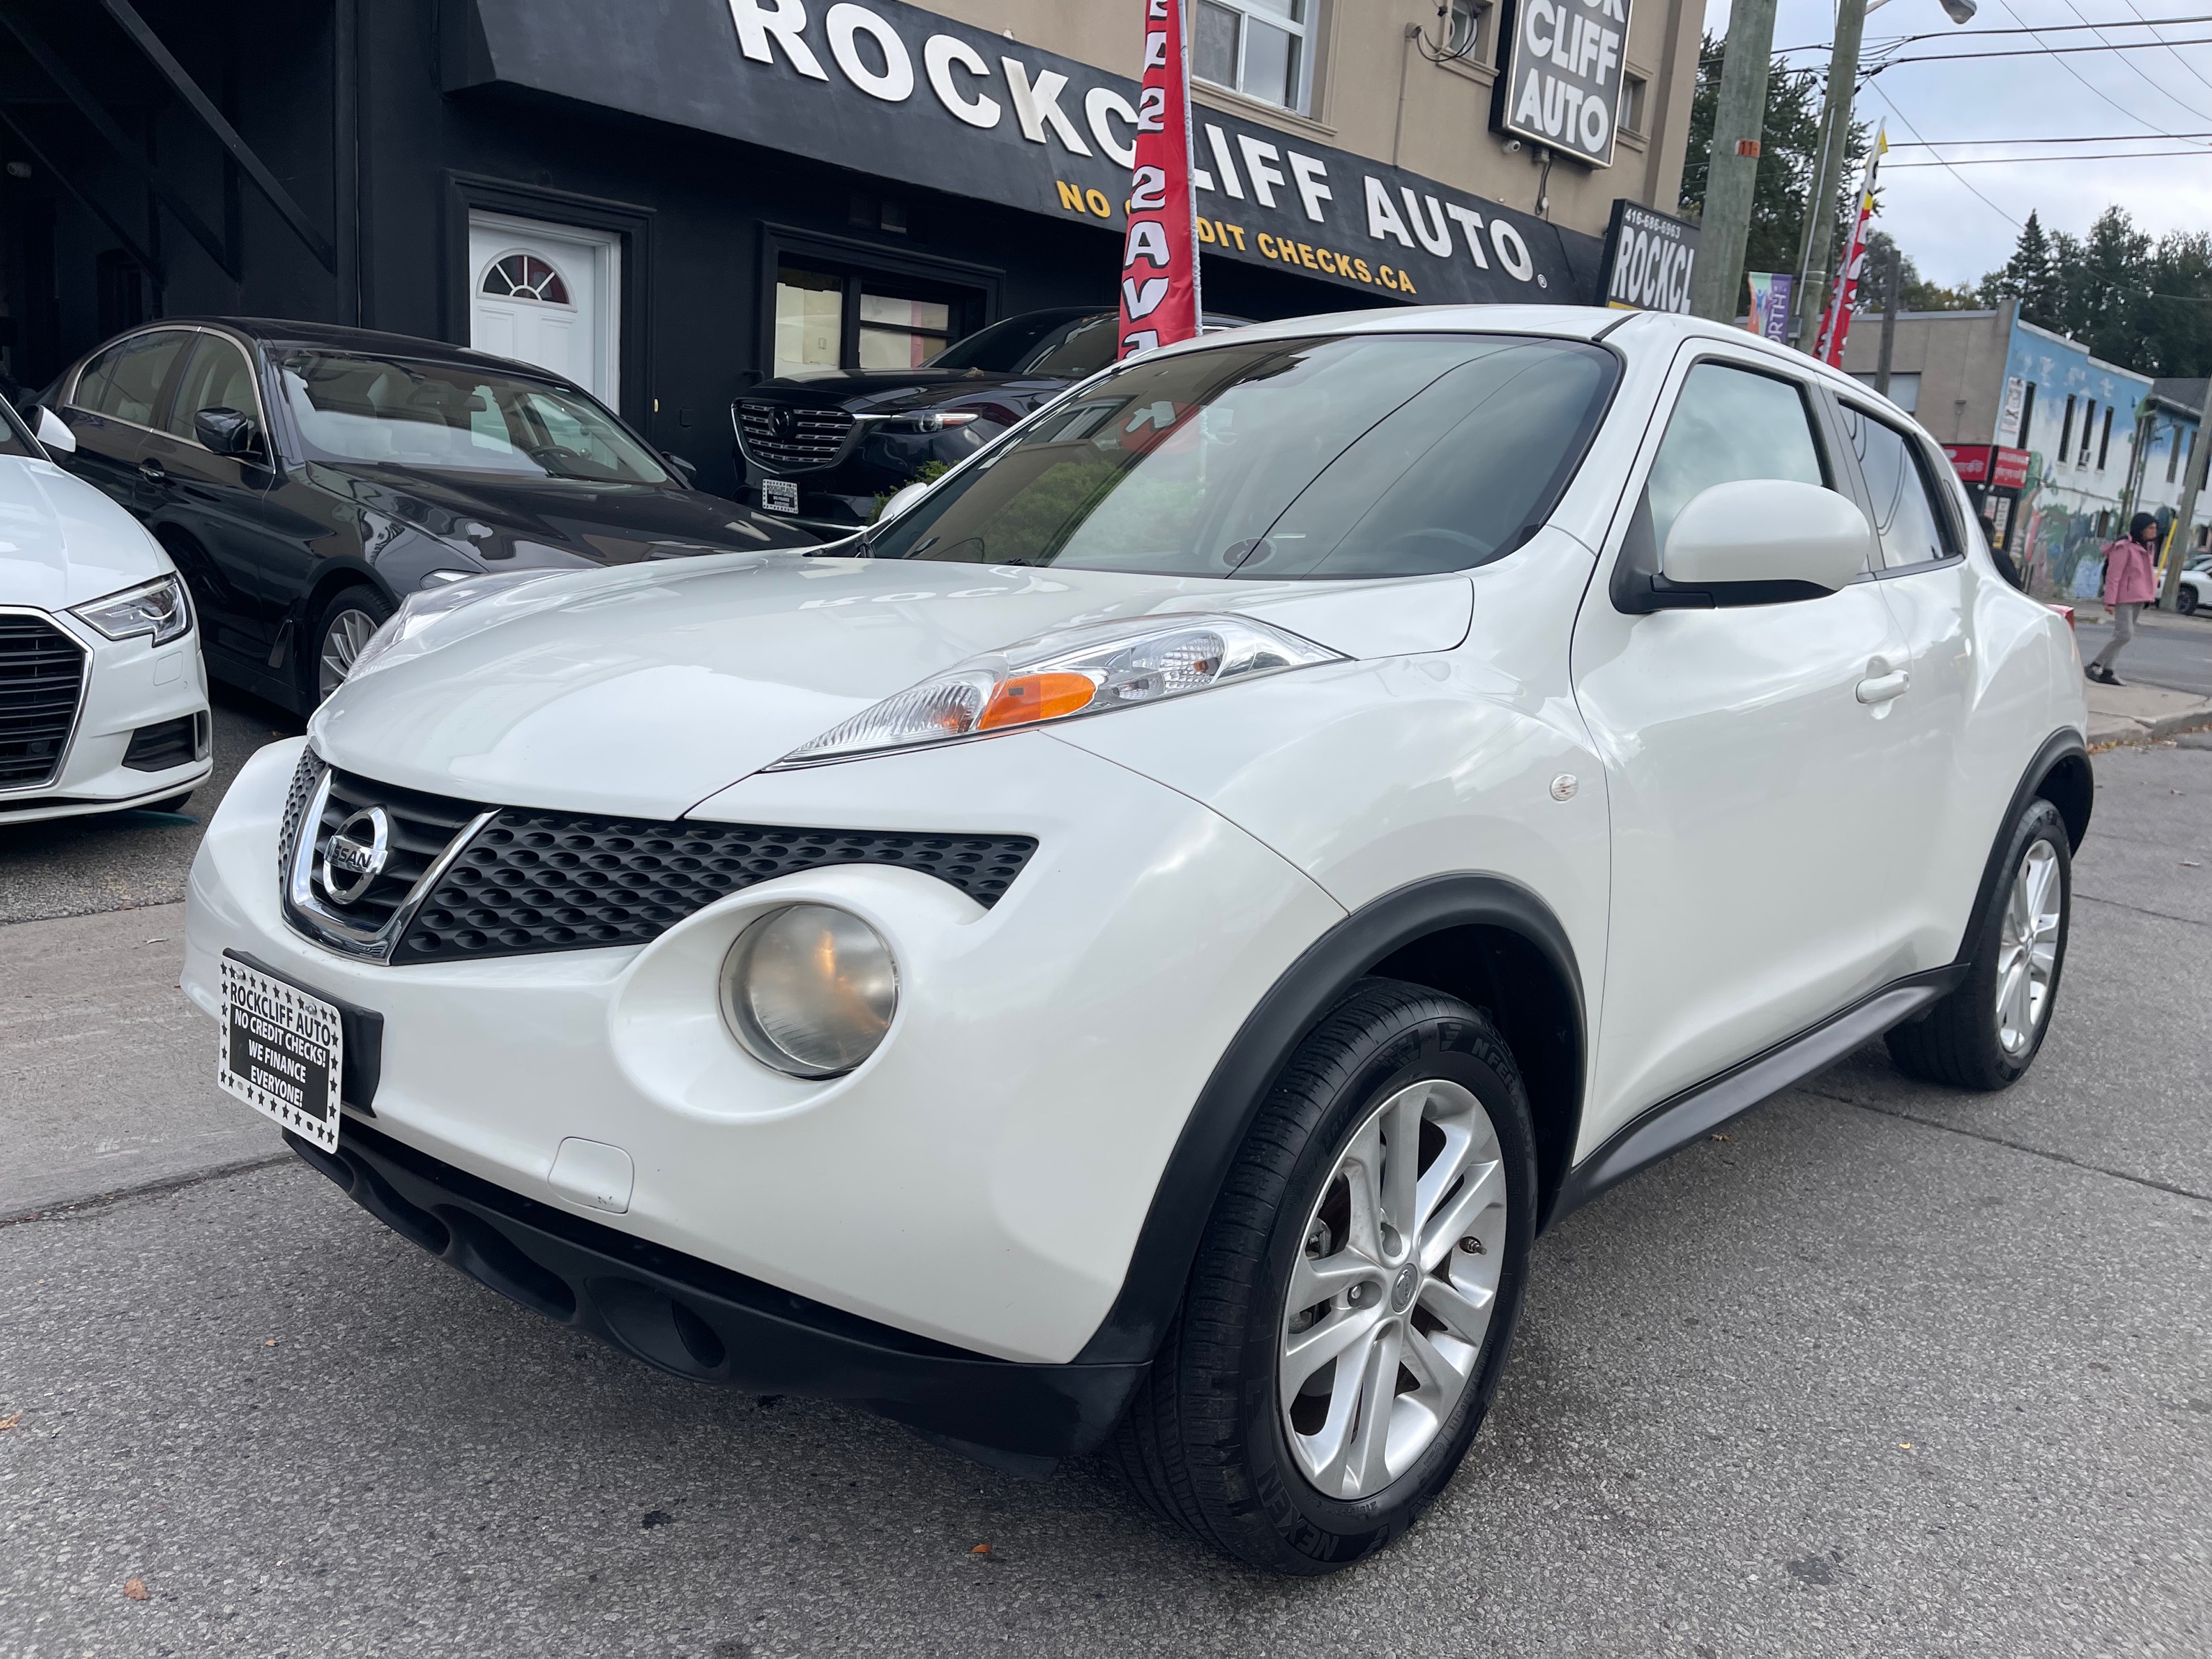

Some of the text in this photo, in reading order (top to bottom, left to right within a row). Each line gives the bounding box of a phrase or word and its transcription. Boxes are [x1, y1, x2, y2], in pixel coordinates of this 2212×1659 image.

[1526, 0, 1620, 86] CLIFF
[728, 0, 1334, 223] ROCKCIFF
[1364, 174, 1534, 282] AUTO
[1515, 67, 1609, 153] AUTO
[1056, 180, 1111, 218] NO
[1257, 233, 1418, 295] CHECKS.CA
[230, 981, 331, 1047] ROCKCLIFF AUTO
[235, 1008, 326, 1069] NO CREDIT CHECKS!
[248, 1038, 306, 1084] WE FINANCE
[251, 1065, 303, 1107] EVERYONE!
[1256, 1462, 1340, 1561] NEXEN
